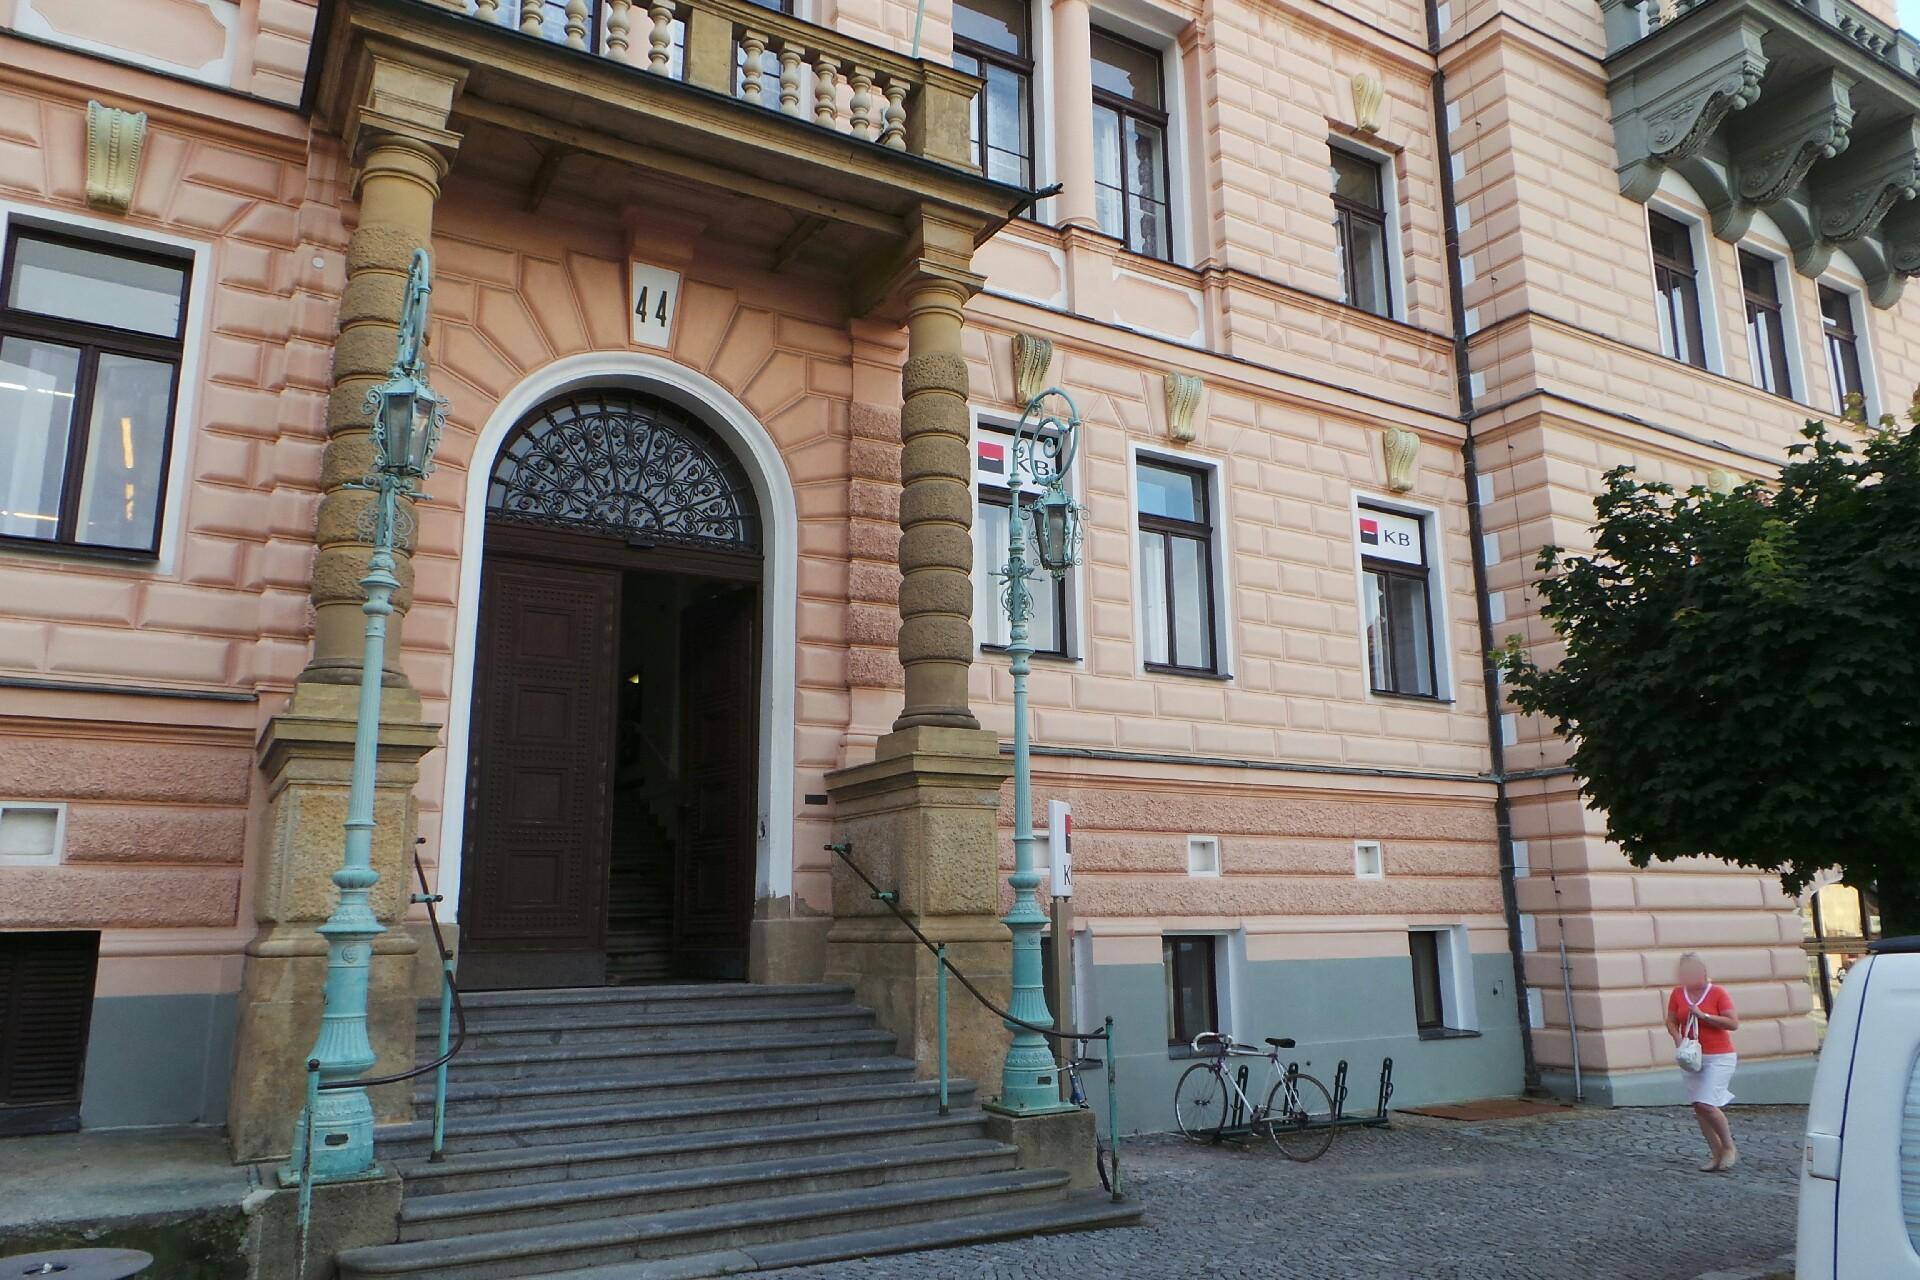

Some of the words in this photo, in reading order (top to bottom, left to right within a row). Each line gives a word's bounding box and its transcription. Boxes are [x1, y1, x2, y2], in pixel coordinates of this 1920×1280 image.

[635, 286, 668, 327] 44
[1016, 458, 1050, 476] KB
[1384, 530, 1410, 546] KB
[1064, 865, 1072, 885] K
